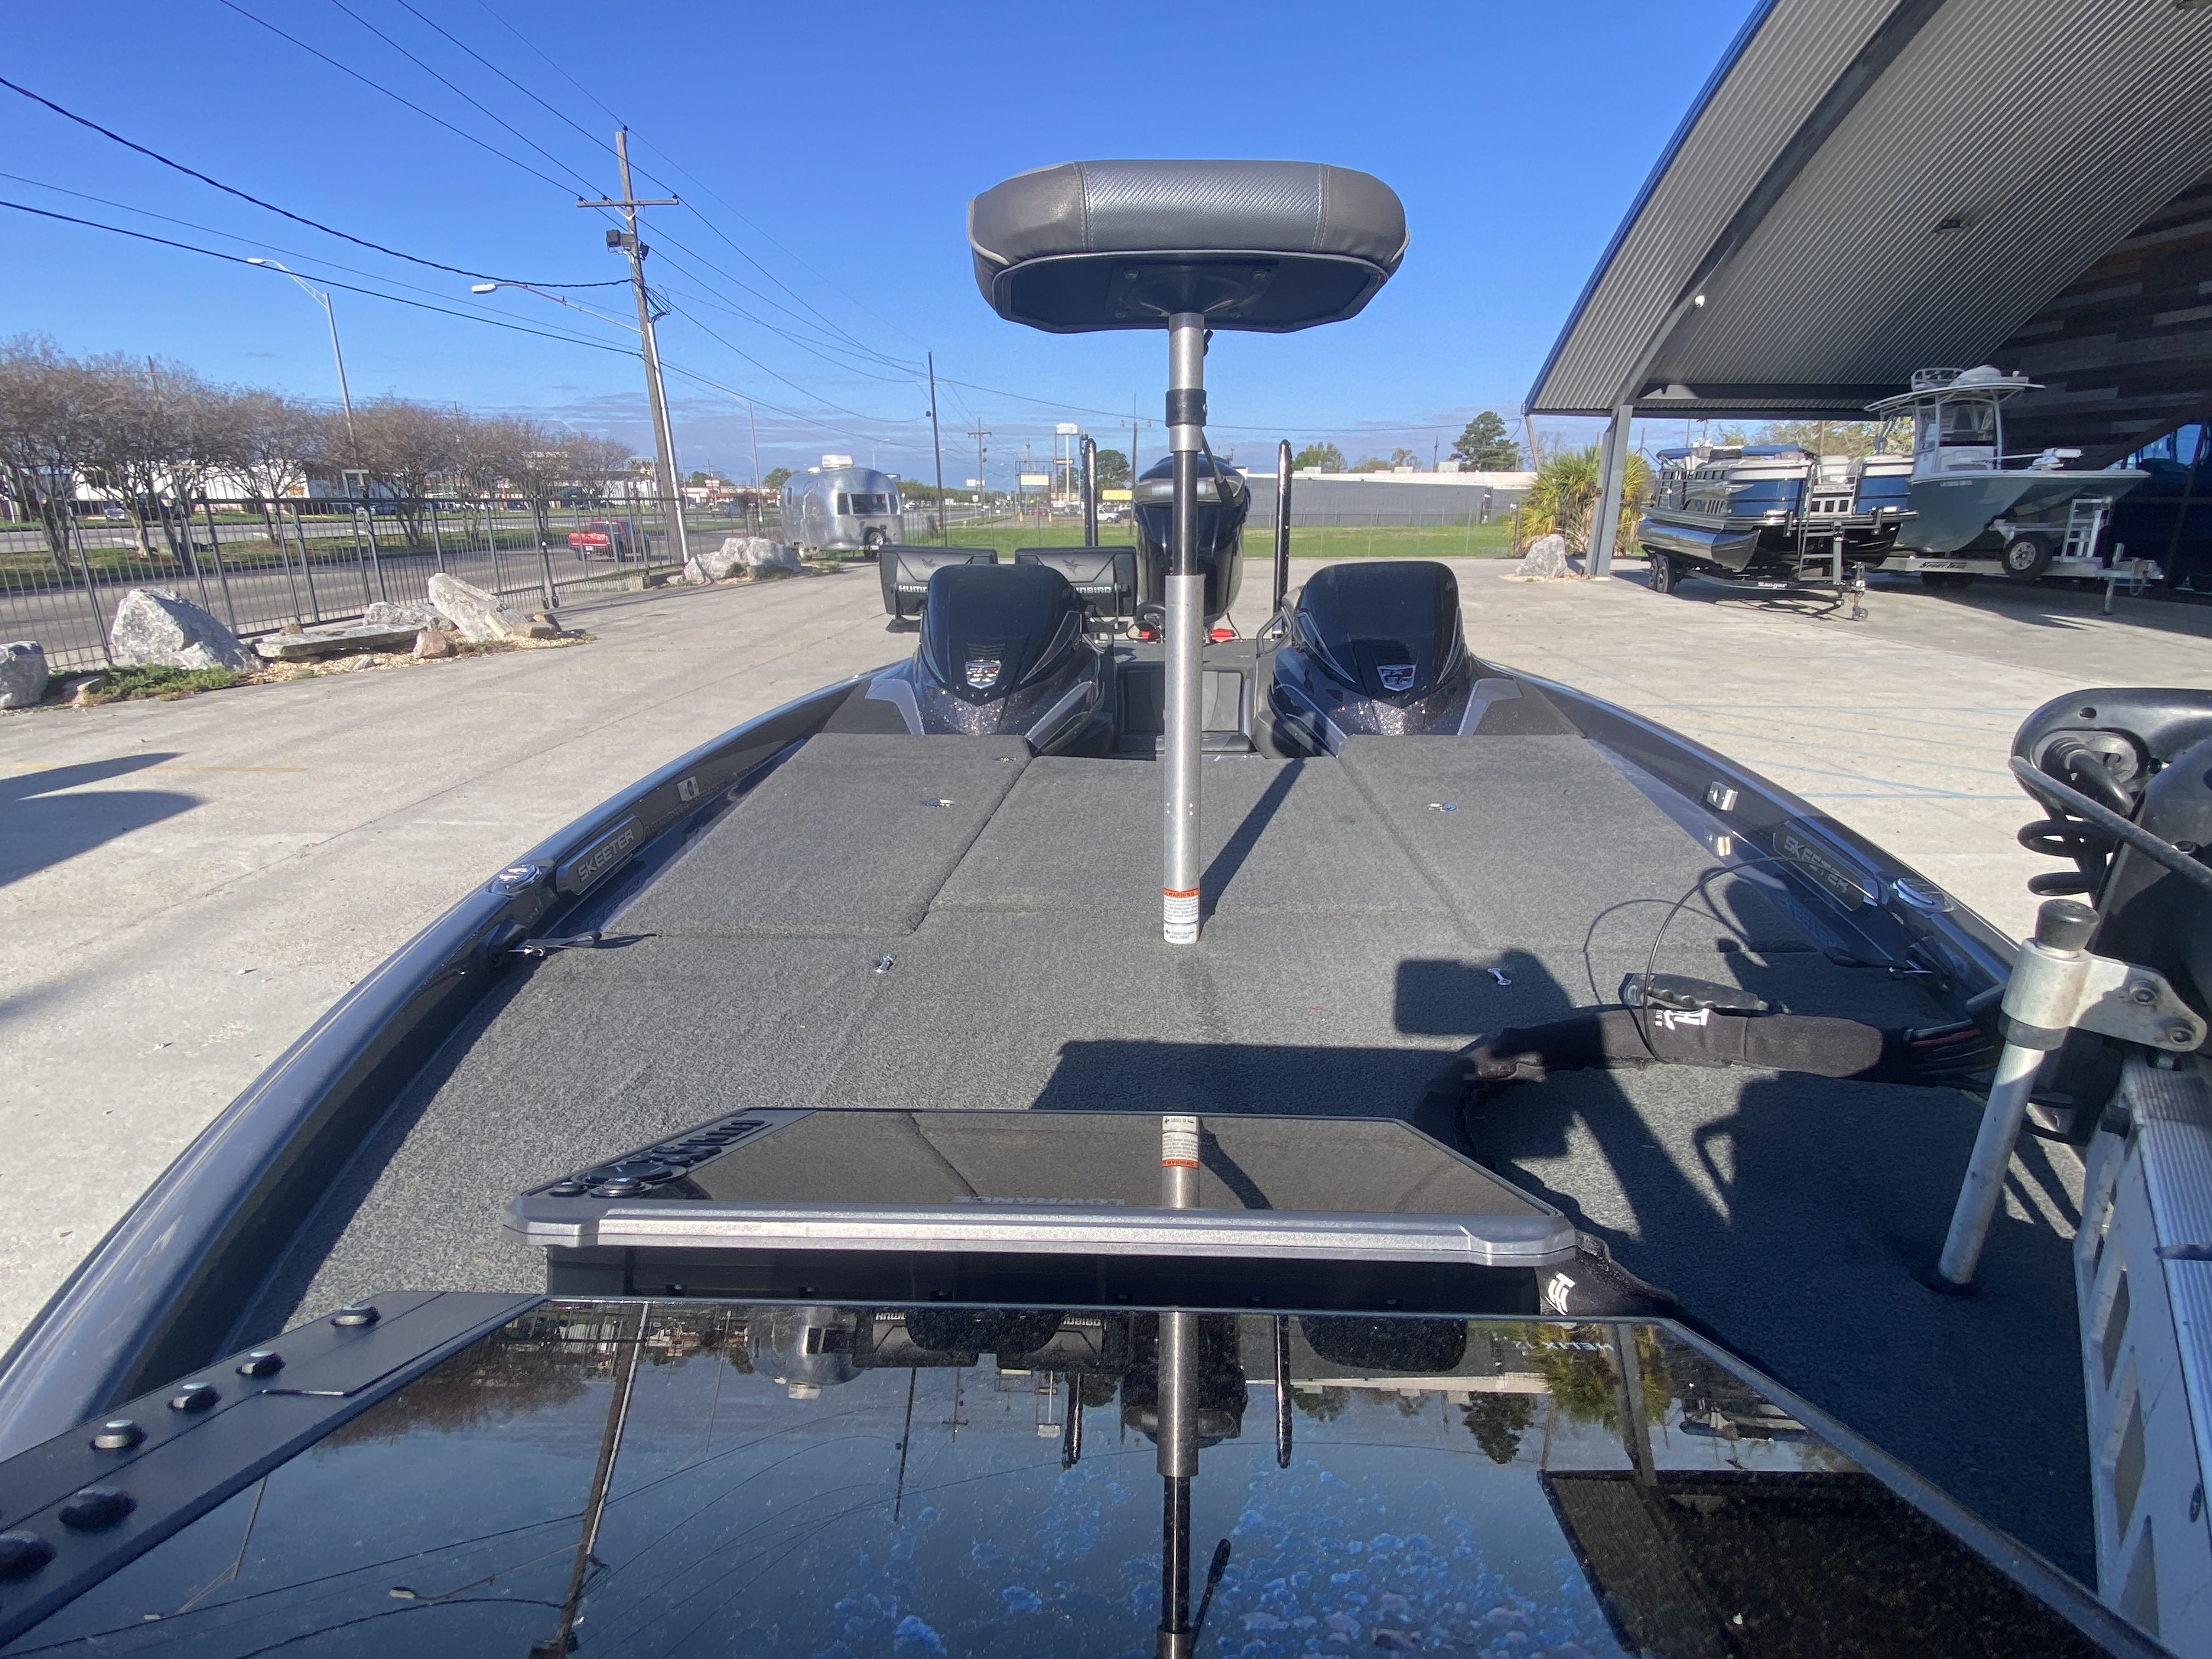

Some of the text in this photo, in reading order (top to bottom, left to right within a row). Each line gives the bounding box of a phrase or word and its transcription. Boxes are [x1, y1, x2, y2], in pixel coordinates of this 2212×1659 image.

[578, 829, 634, 882] SKEETER
[1784, 835, 1849, 894] SKEETER
[951, 1196, 1125, 1206] LOWRANCE
[1542, 1342, 1615, 1351] HELIX
